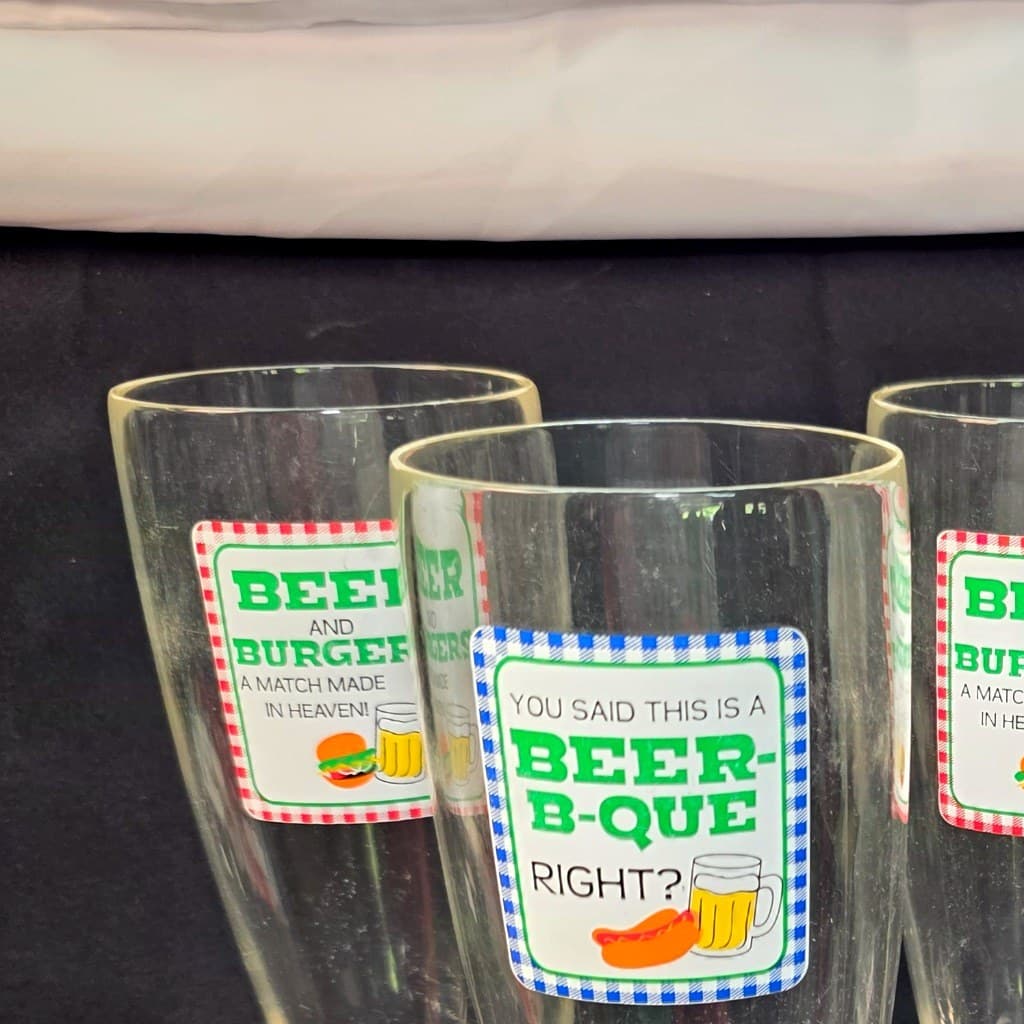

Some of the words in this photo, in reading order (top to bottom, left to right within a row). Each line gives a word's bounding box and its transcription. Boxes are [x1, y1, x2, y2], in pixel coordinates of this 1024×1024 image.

[309, 618, 355, 637] AND
[231, 634, 410, 668] BURGER
[240, 675, 253, 691] A
[255, 676, 322, 694] MATCH
[327, 674, 387, 693] MADE
[960, 683, 972, 699] A
[264, 702, 284, 719] IN
[288, 701, 369, 719] HEAVEN!
[509, 692, 562, 720] YOU
[572, 698, 635, 723] SAID
[644, 699, 708, 723] THIS
[717, 696, 740, 720] IS
[749, 694, 767, 717] A
[980, 711, 998, 728] IN
[509, 728, 777, 785] BEER-
[526, 789, 758, 851] B-QUE
[531, 860, 683, 901] RIGHT?
